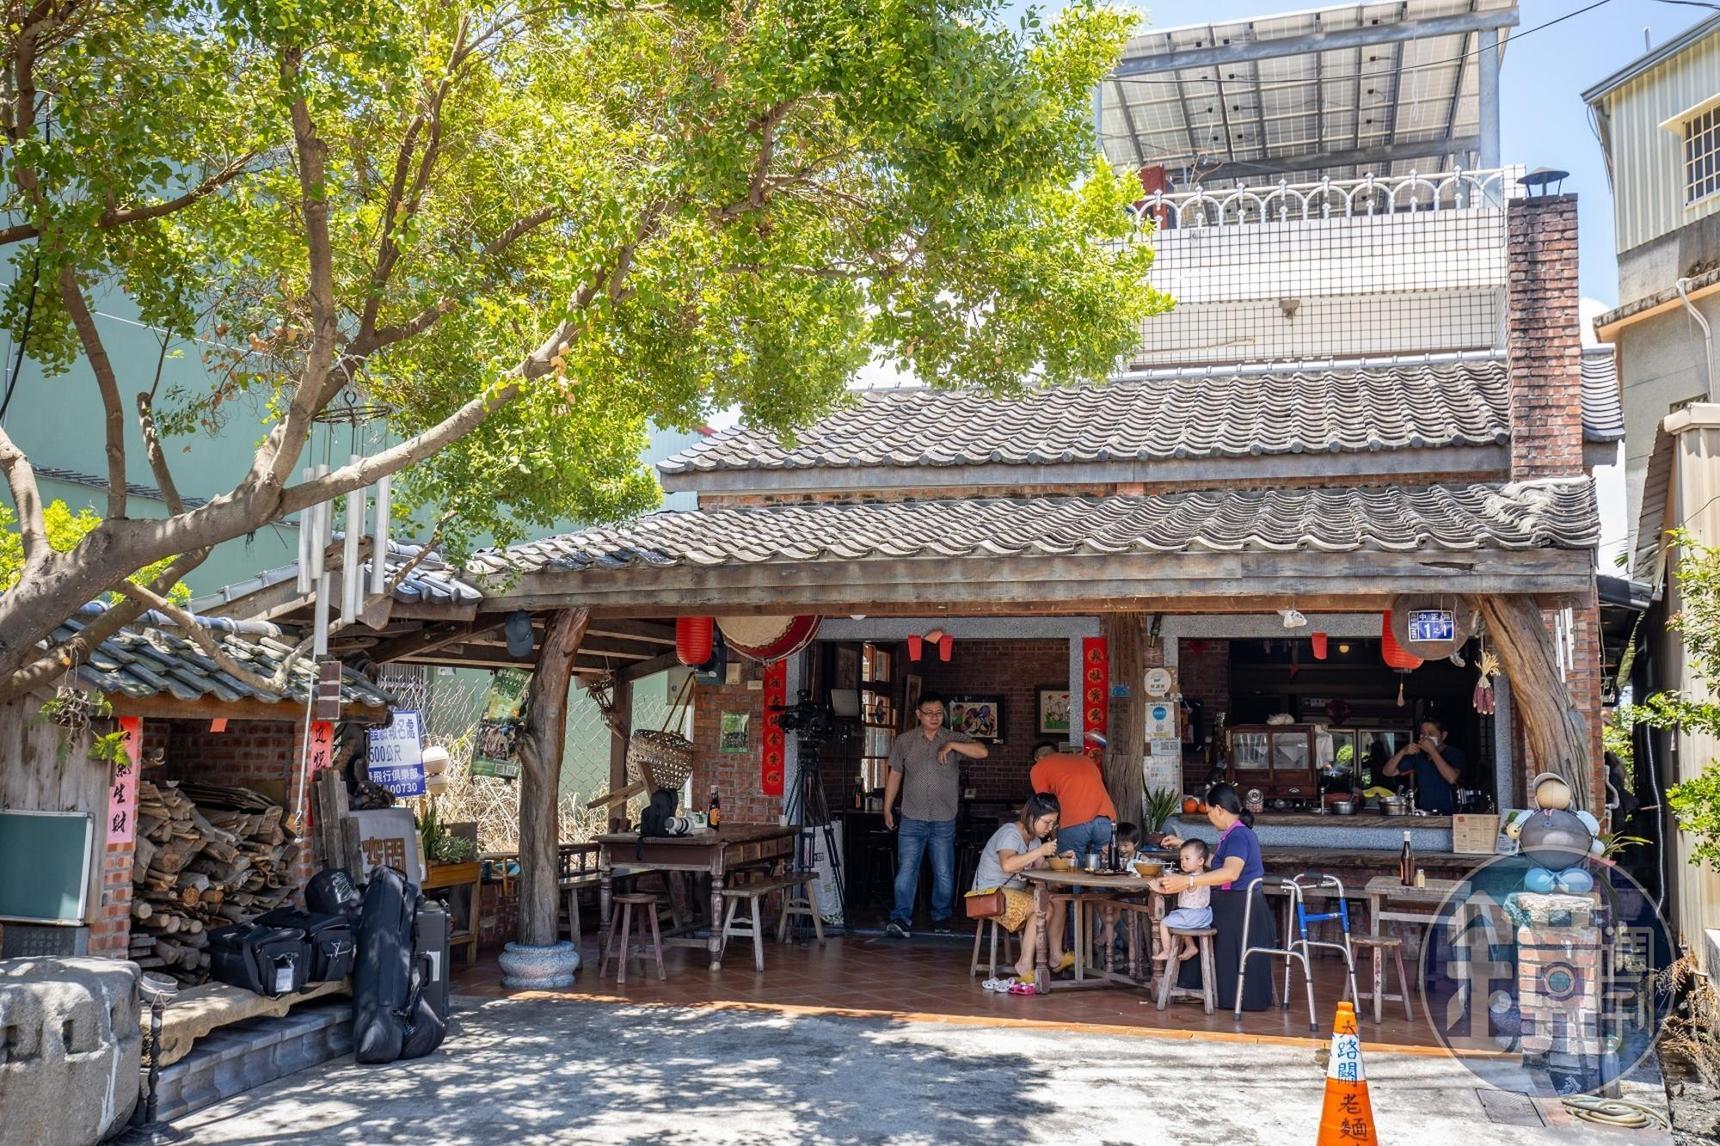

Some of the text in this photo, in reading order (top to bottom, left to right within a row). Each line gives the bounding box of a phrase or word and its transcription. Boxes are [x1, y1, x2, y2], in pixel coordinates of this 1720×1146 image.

[369, 768, 419, 783] 飛行俱樂部
[1337, 1020, 1369, 1146] 大路關老麵
